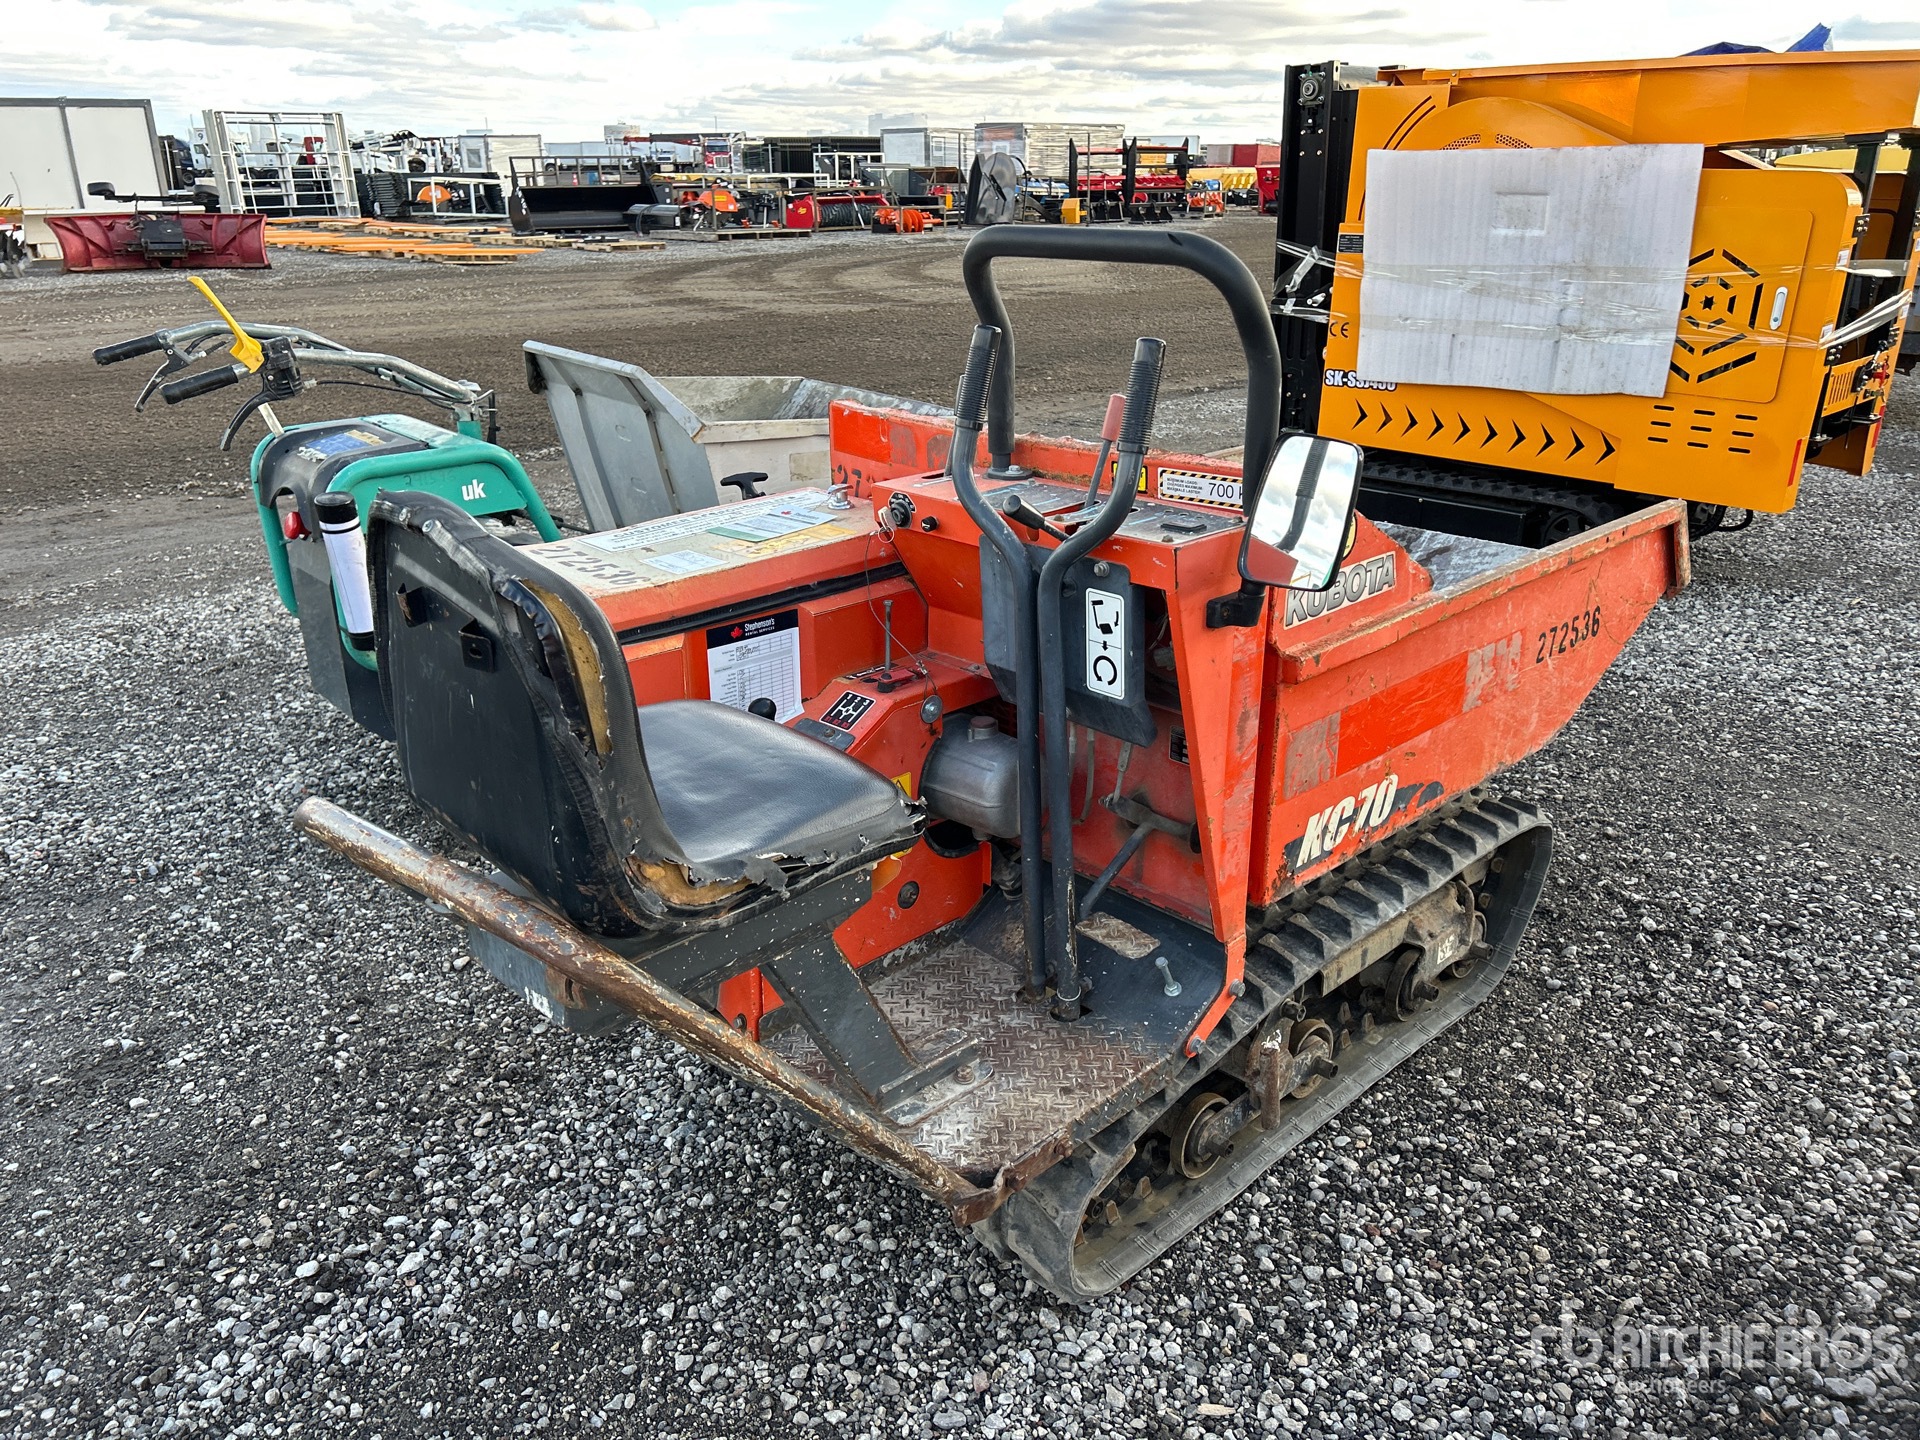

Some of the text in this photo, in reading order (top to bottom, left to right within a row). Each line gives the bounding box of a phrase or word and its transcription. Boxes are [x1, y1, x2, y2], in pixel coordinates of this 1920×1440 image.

[461, 478, 487, 501] uk
[1209, 482, 1234, 499] 700
[529, 545, 651, 586] 272536
[1285, 553, 1395, 628] KUBOTA
[1535, 605, 1601, 664] 272536
